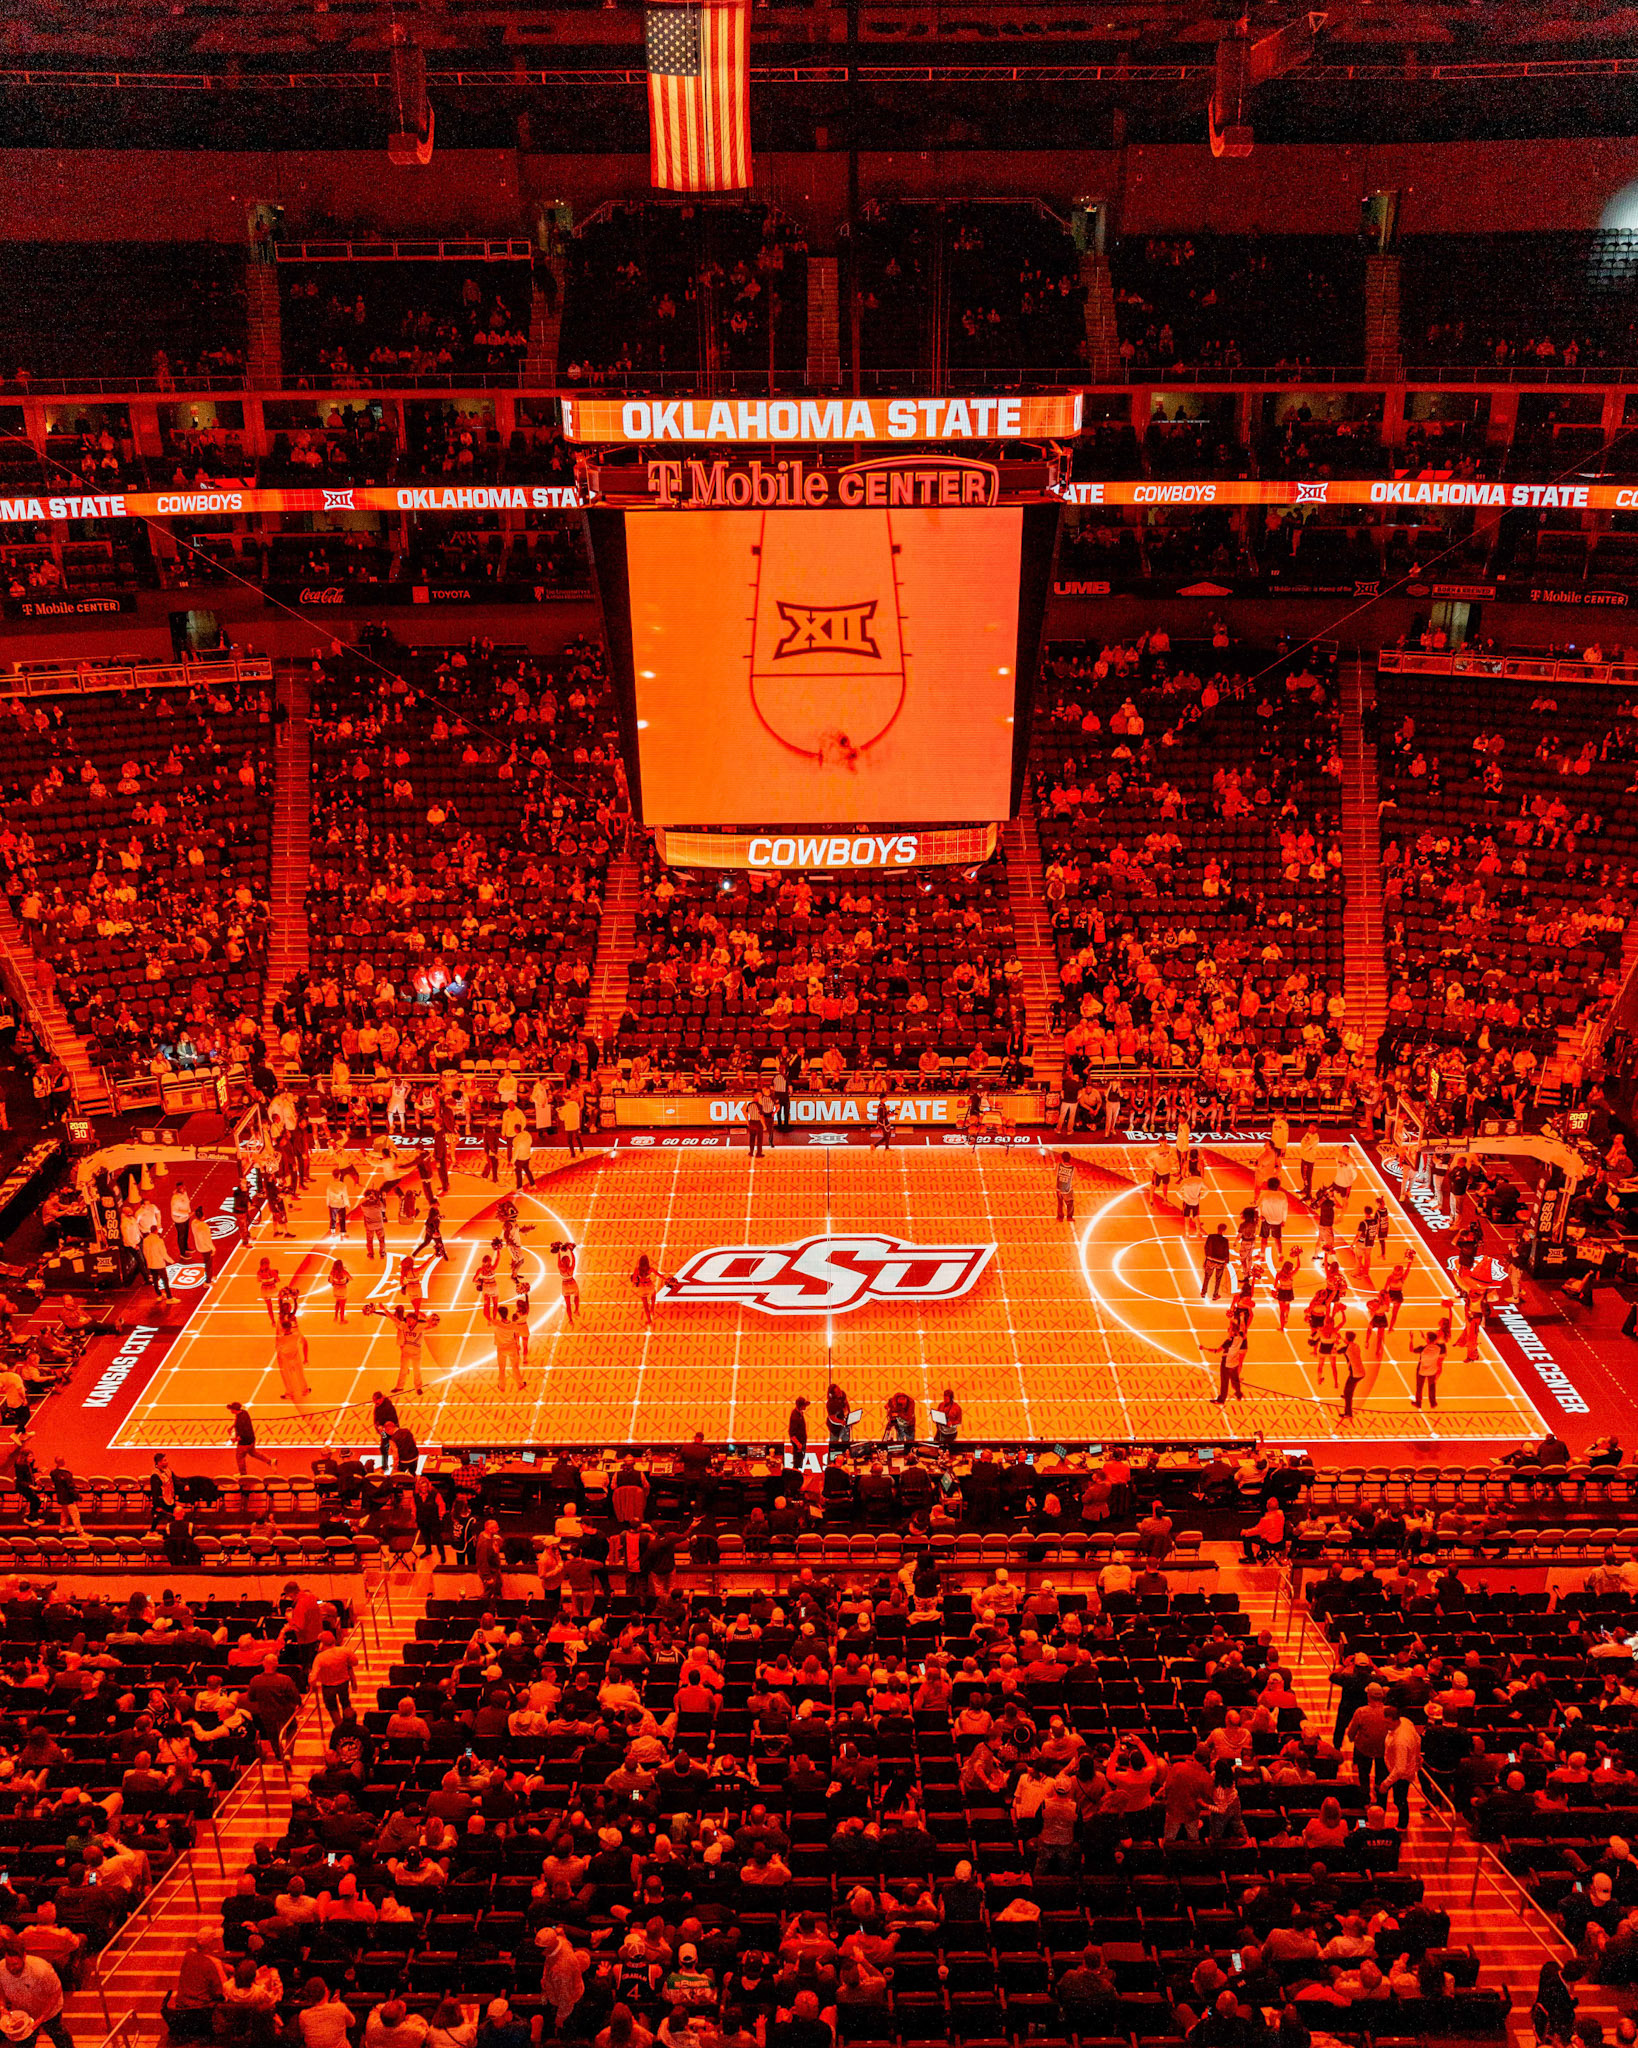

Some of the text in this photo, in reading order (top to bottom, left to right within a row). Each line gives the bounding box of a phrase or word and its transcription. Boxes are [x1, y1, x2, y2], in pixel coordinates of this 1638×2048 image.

[622, 398, 1022, 440] OKLAHOMA STATE
[687, 460, 829, 507] Mobile
[838, 470, 987, 506] CENTER
[397, 488, 528, 509] OKLAHOMA
[1133, 485, 1217, 502] COWBOYS
[1371, 483, 1590, 507] OKLAHOMA STATE
[49, 496, 127, 518] STATE
[157, 493, 243, 513] COWBOYS
[300, 587, 346, 604] Coca-Cola
[432, 590, 471, 599] TOYOTA
[1054, 581, 1111, 595] UMB
[1543, 589, 1582, 604] Mobile
[1584, 593, 1625, 606] CENTER
[35, 603, 75, 615] Mobile
[77, 602, 118, 613] CENTER
[748, 835, 919, 866] COWBOYS
[1569, 1112, 1588, 1121] 20:00
[1571, 1120, 1584, 1129] 30
[75, 1129, 87, 1139] 30
[662, 1137, 719, 1146] GO GO GO
[1013, 1135, 1031, 1144] GO
[1542, 1202, 1555, 1212] GO
[105, 1210, 117, 1220] GO
[1540, 1212, 1553, 1222] GO
[106, 1219, 119, 1229] GO
[1539, 1221, 1552, 1232] GO
[107, 1229, 120, 1239] GO
[664, 1236, 988, 1311] OSU
[1493, 1303, 1591, 1414] T-MOBILE CENTER
[81, 1325, 160, 1408] KANSAS CITY
[626, 1983, 642, 2001] 4
